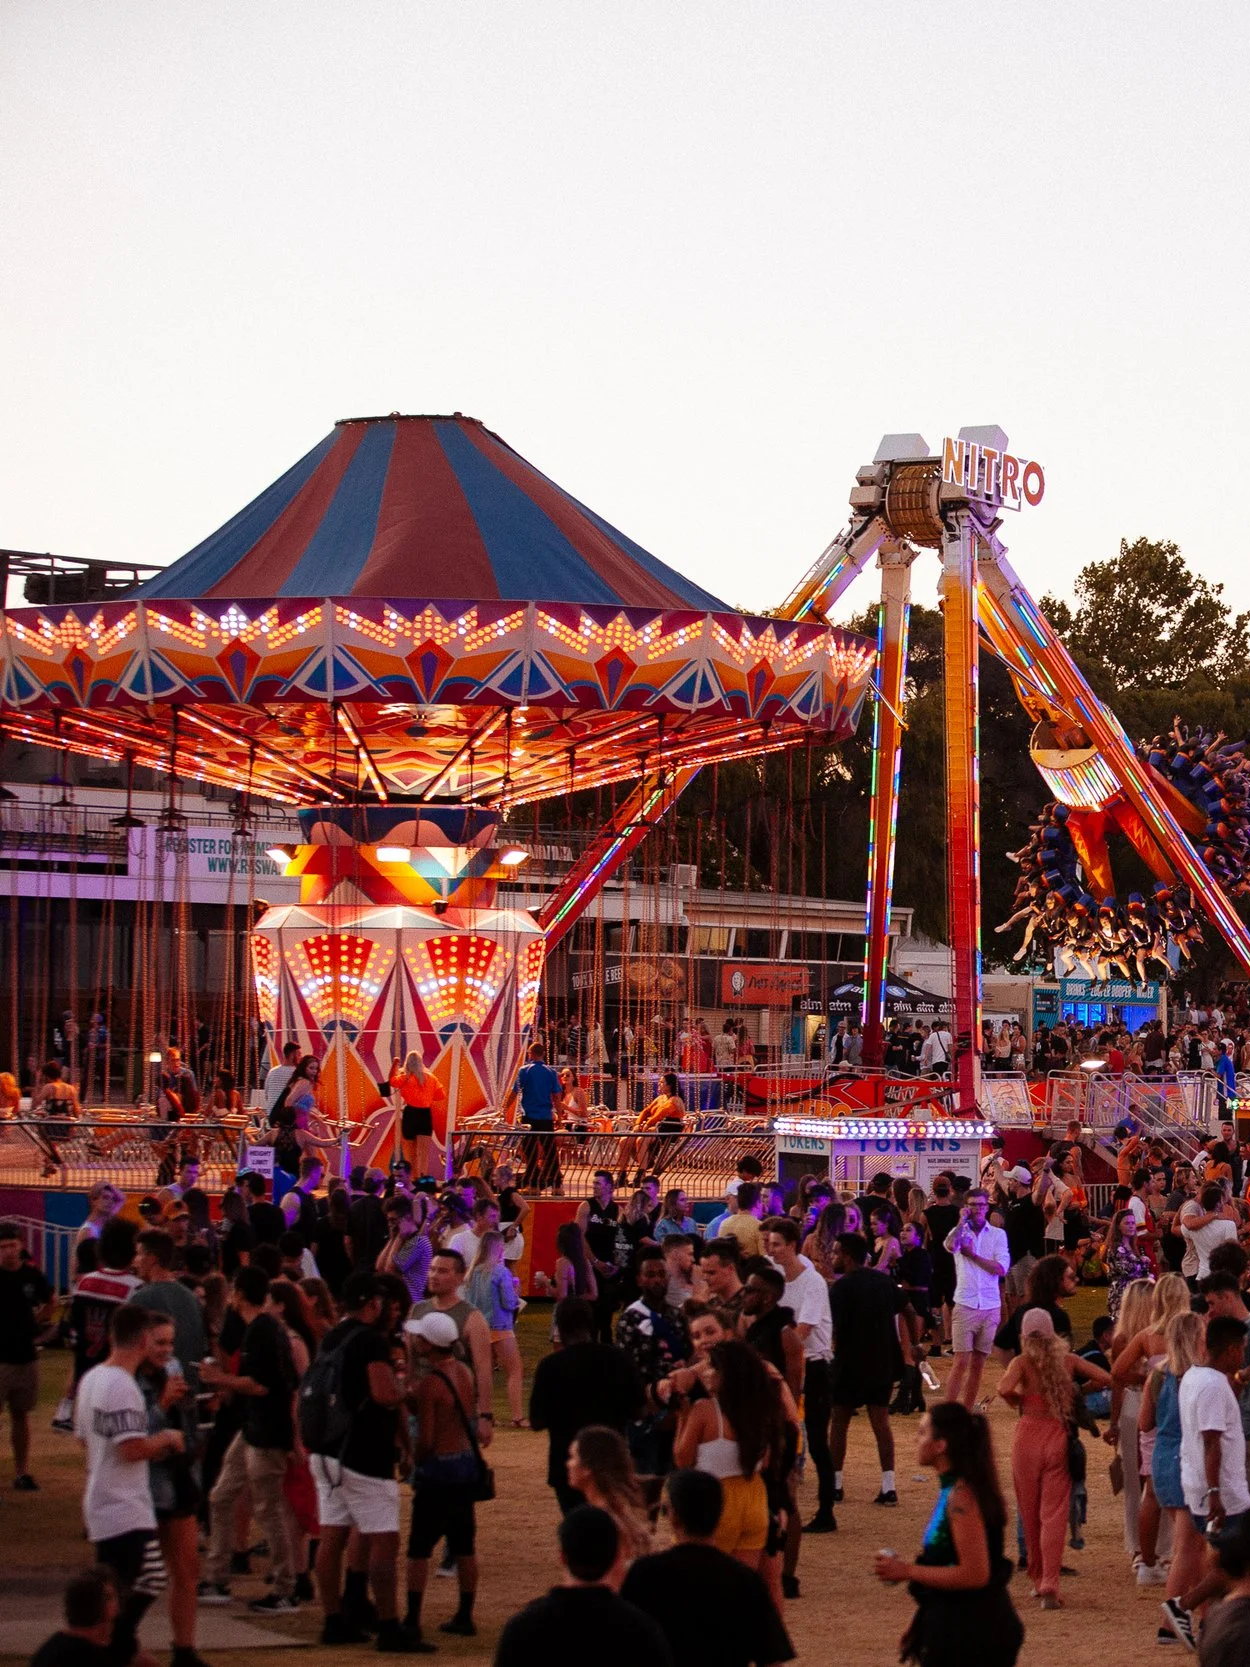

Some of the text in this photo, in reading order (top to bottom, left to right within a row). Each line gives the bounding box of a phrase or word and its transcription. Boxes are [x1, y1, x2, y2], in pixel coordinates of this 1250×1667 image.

[943, 437, 1045, 506] NITRO
[166, 836, 215, 854] RESTER
[800, 998, 823, 1010] atm
[829, 1000, 852, 1011] atm
[783, 1136, 825, 1150] TOKENS
[859, 1139, 961, 1152] TOKENS
